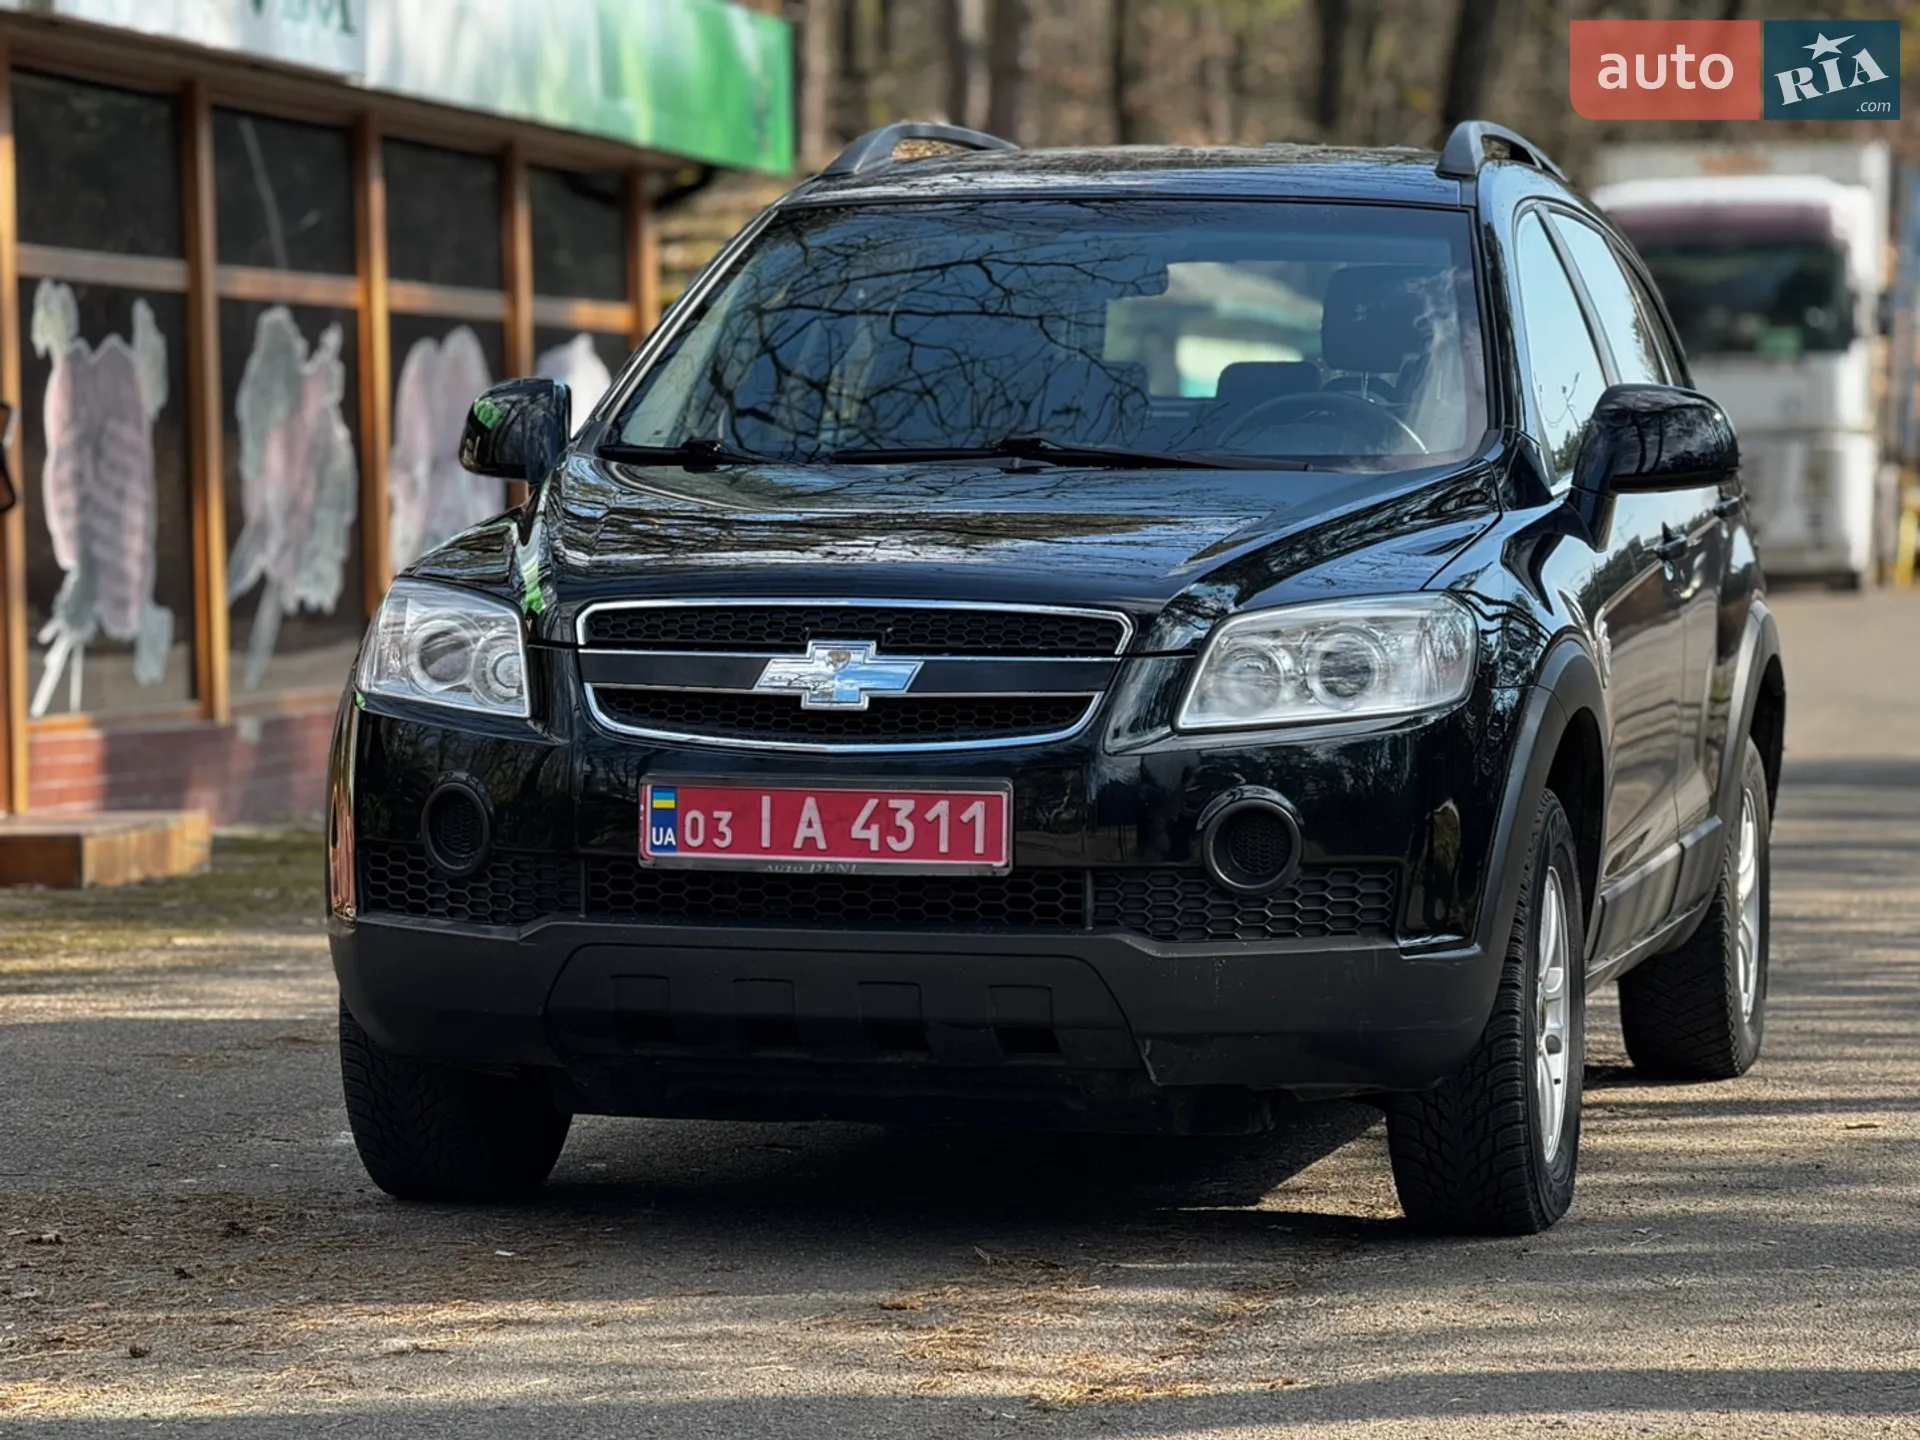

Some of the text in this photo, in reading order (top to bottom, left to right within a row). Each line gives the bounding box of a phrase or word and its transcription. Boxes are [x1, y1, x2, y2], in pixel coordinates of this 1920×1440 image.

[651, 826, 677, 846] UA
[684, 809, 733, 848] 03
[850, 797, 986, 855] 4311
